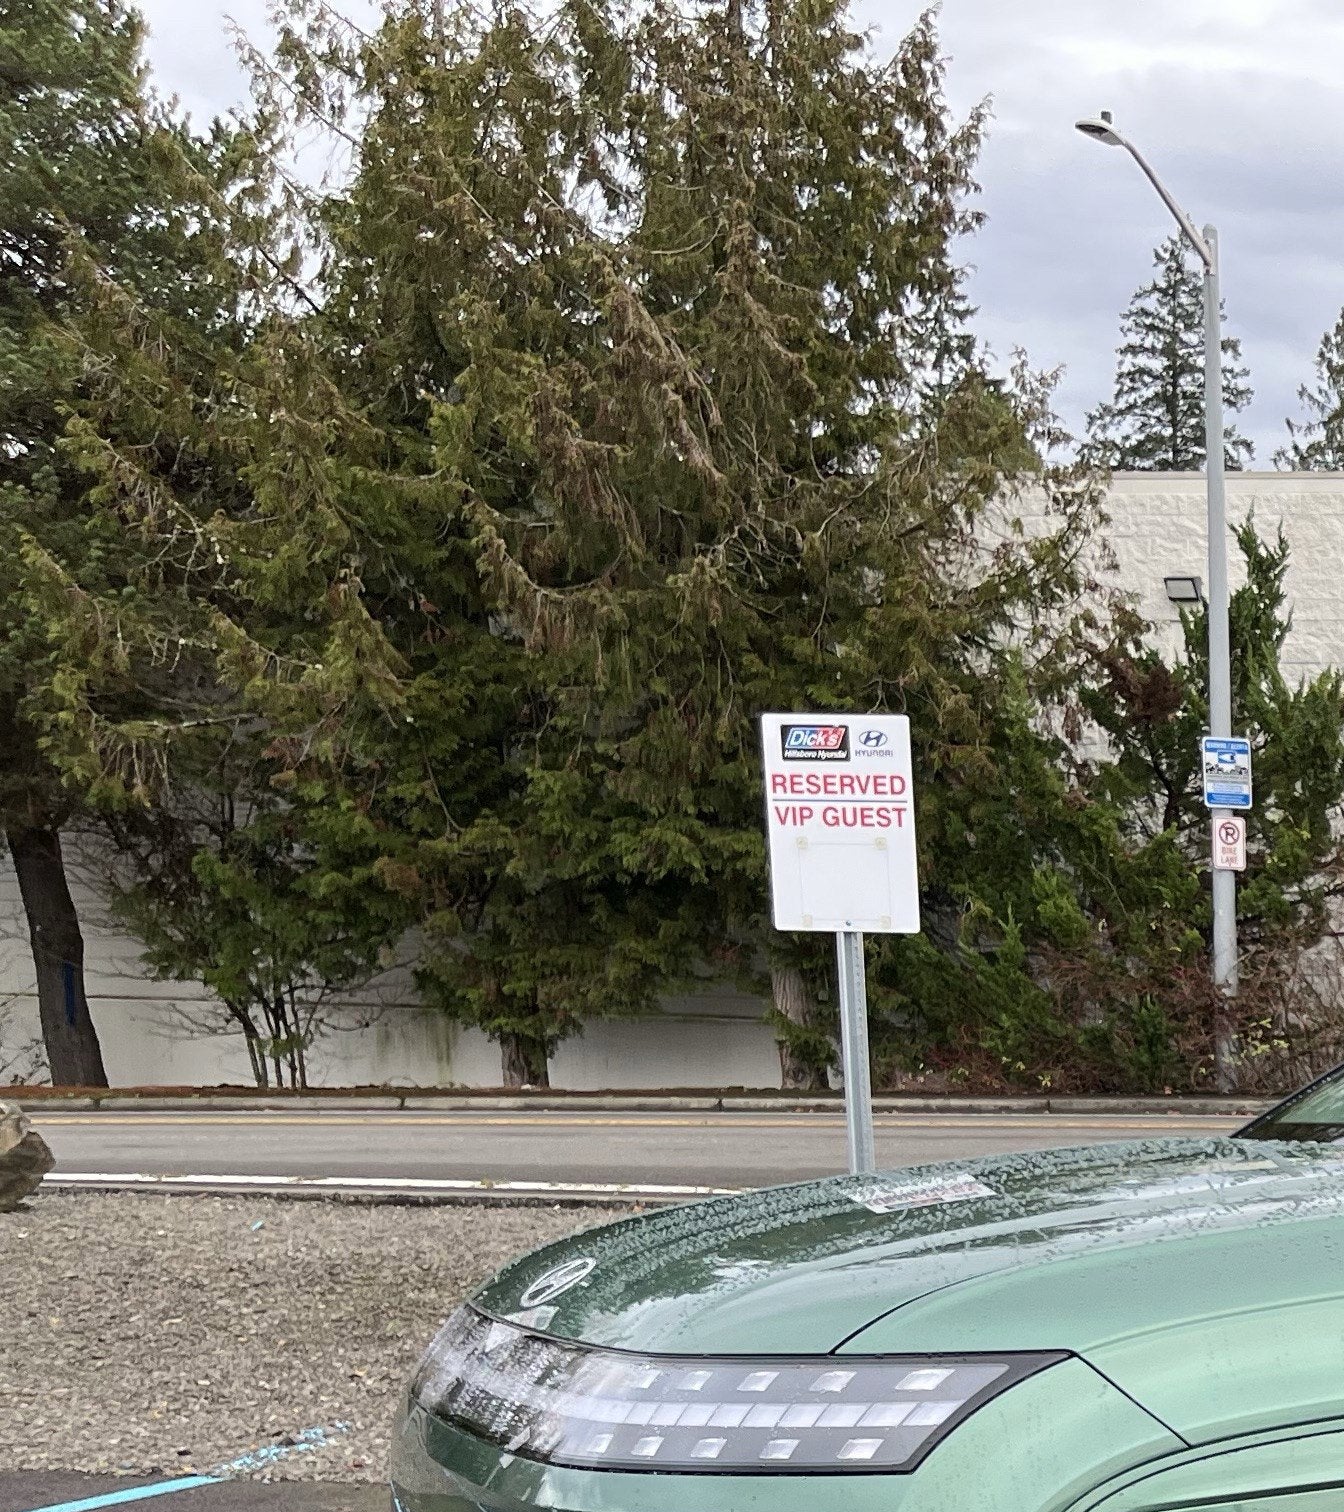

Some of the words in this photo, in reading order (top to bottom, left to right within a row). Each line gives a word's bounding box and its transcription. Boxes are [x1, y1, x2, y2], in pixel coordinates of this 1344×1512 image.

[772, 774, 906, 795] RESERVED
[775, 806, 814, 826] VIP
[822, 806, 907, 828] GUEST
